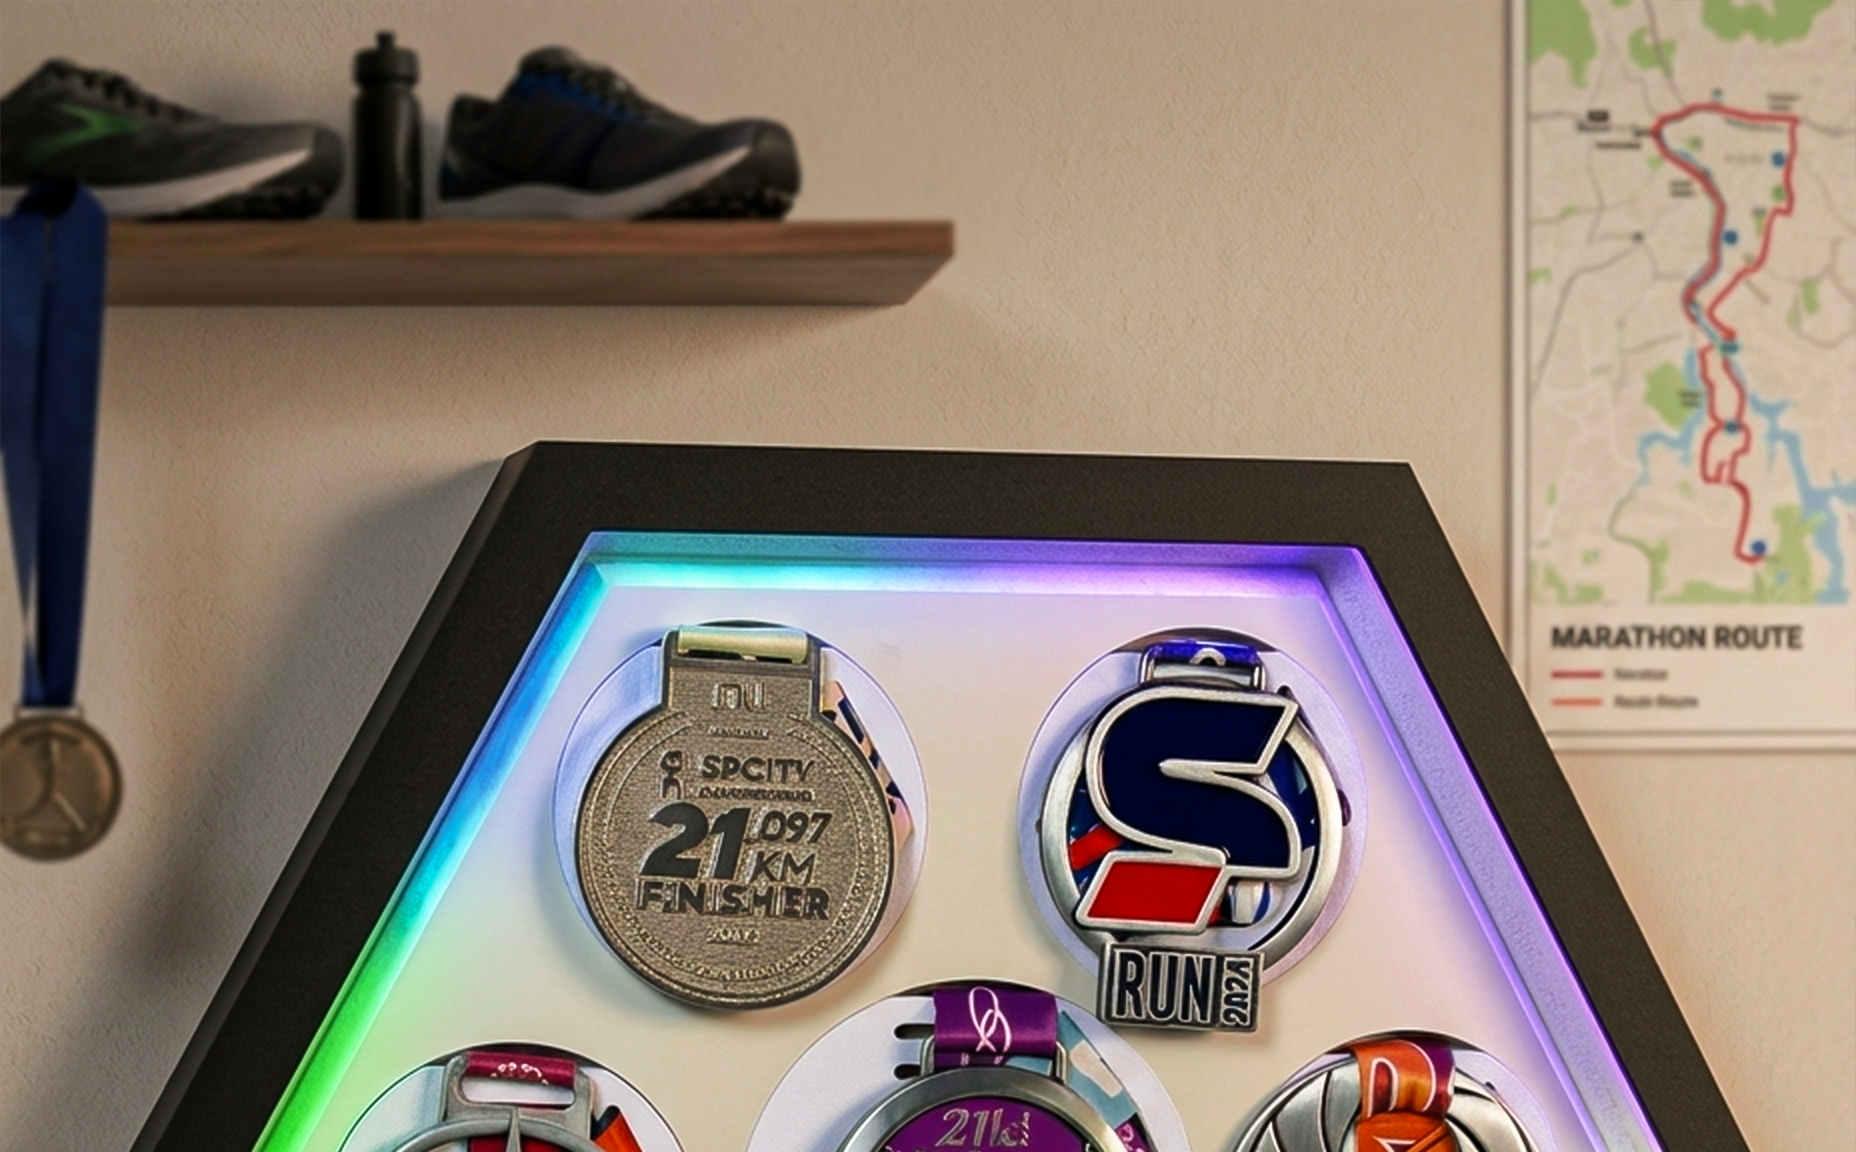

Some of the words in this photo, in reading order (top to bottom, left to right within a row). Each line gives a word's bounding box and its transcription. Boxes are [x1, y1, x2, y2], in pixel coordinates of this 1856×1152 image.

[1551, 625, 1706, 649] MARATHON
[1714, 625, 1803, 649] ROUTE
[640, 802, 751, 880] 21
[749, 850, 816, 886] KM
[635, 880, 829, 920] FINISHER
[1114, 951, 1213, 1024] RUN
